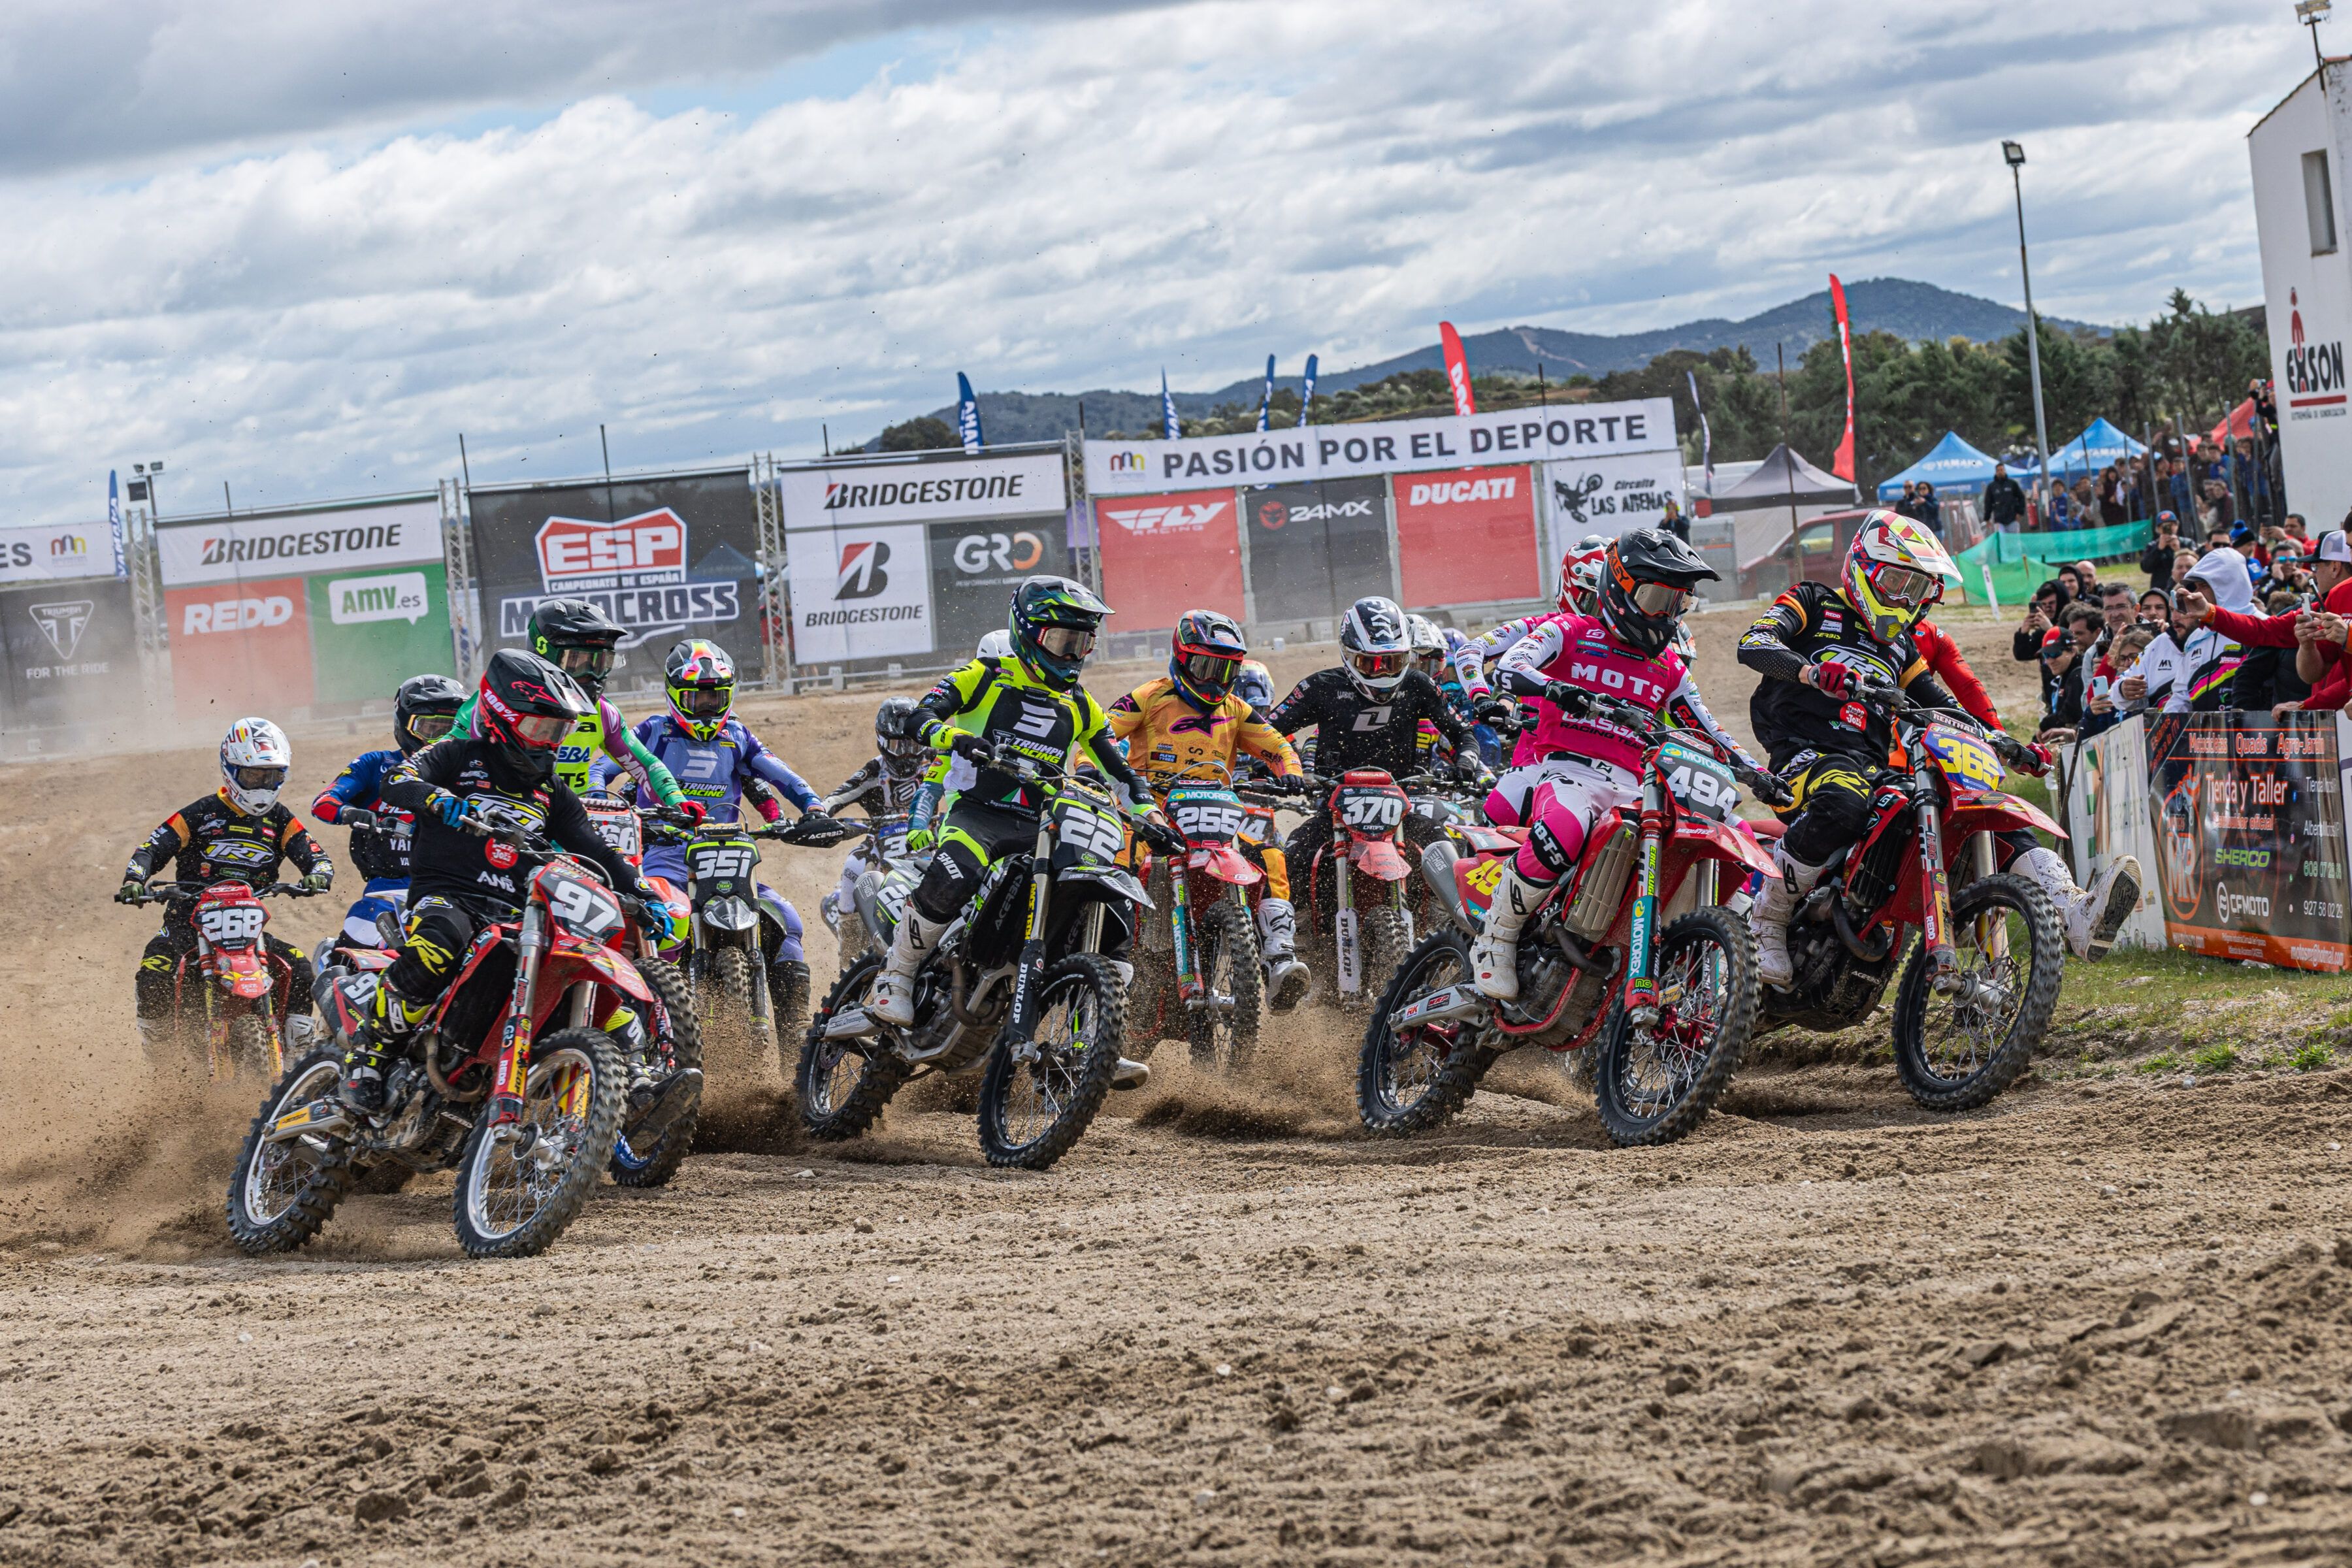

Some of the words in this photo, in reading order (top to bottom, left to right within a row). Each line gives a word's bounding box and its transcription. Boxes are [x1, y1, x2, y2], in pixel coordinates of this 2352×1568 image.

[1163, 439, 1305, 478] PASIÓN
[1320, 436, 1397, 465] POR
[1411, 431, 1456, 458] EL
[1471, 414, 1647, 453] DEPORTE
[824, 474, 1024, 510] BRIDGESTONE
[1410, 477, 1516, 506] DUCATI
[1591, 495, 1616, 516] LAS
[1105, 501, 1228, 531] FLY
[1290, 500, 1373, 523] 24MX
[201, 523, 402, 566] BRIDGESTONE
[1132, 525, 1204, 536] RACING
[546, 526, 679, 573] ESP
[953, 532, 1043, 574] GRO
[551, 579, 618, 593] CAMPEONATO
[621, 576, 636, 586] DE
[640, 570, 681, 585] ESPAÑA
[183, 596, 293, 636] REDD
[505, 585, 736, 636] MOCROSS
[806, 604, 924, 628] BRIDGESTONE
[26, 667, 50, 679] FOR
[54, 664, 78, 678] THE
[81, 661, 110, 675] RIDE
[1571, 662, 1665, 703] MOTS
[483, 688, 519, 723] 100%
[1560, 722, 1614, 740] RACING
[1933, 712, 1976, 734] RENTHAL
[1013, 737, 1064, 758] TRIUMPH
[2235, 732, 2267, 757] Quads
[1682, 751, 1731, 780] MOTOREX
[1938, 738, 2000, 791] 365
[681, 789, 727, 798] RACING
[683, 782, 728, 791] TRIUMPH
[1186, 791, 1234, 802] MOTOREX
[1667, 765, 1737, 819] 494
[2206, 772, 2237, 804] Tienda
[2240, 781, 2249, 812] y
[2251, 773, 2289, 806] Taller
[580, 798, 629, 809] NTHAL
[1342, 796, 1403, 826] 370
[808, 830, 844, 840] ACERBIS
[1060, 807, 1122, 864] 22
[1176, 807, 1242, 836] 255
[206, 841, 273, 863] TRT
[696, 850, 751, 879] 351
[938, 852, 964, 880] SHOT
[1648, 845, 1658, 872] ERIC
[2215, 849, 2270, 868] SHERCO
[1465, 859, 1503, 896] 49
[549, 880, 617, 934] 97
[1028, 883, 1037, 913] RACE
[2230, 894, 2269, 917] CFMOTO
[2303, 900, 2317, 915] 927
[201, 909, 264, 942] 268
[1024, 913, 1034, 940] TECH
[1926, 915, 1936, 941] REDD
[1173, 924, 1183, 972] MOTOREX
[1629, 917, 1645, 978] MOTOREX
[1014, 962, 1029, 1024] DUNLOP
[1406, 1005, 1419, 1017] RK
[497, 1059, 510, 1086] REDD
